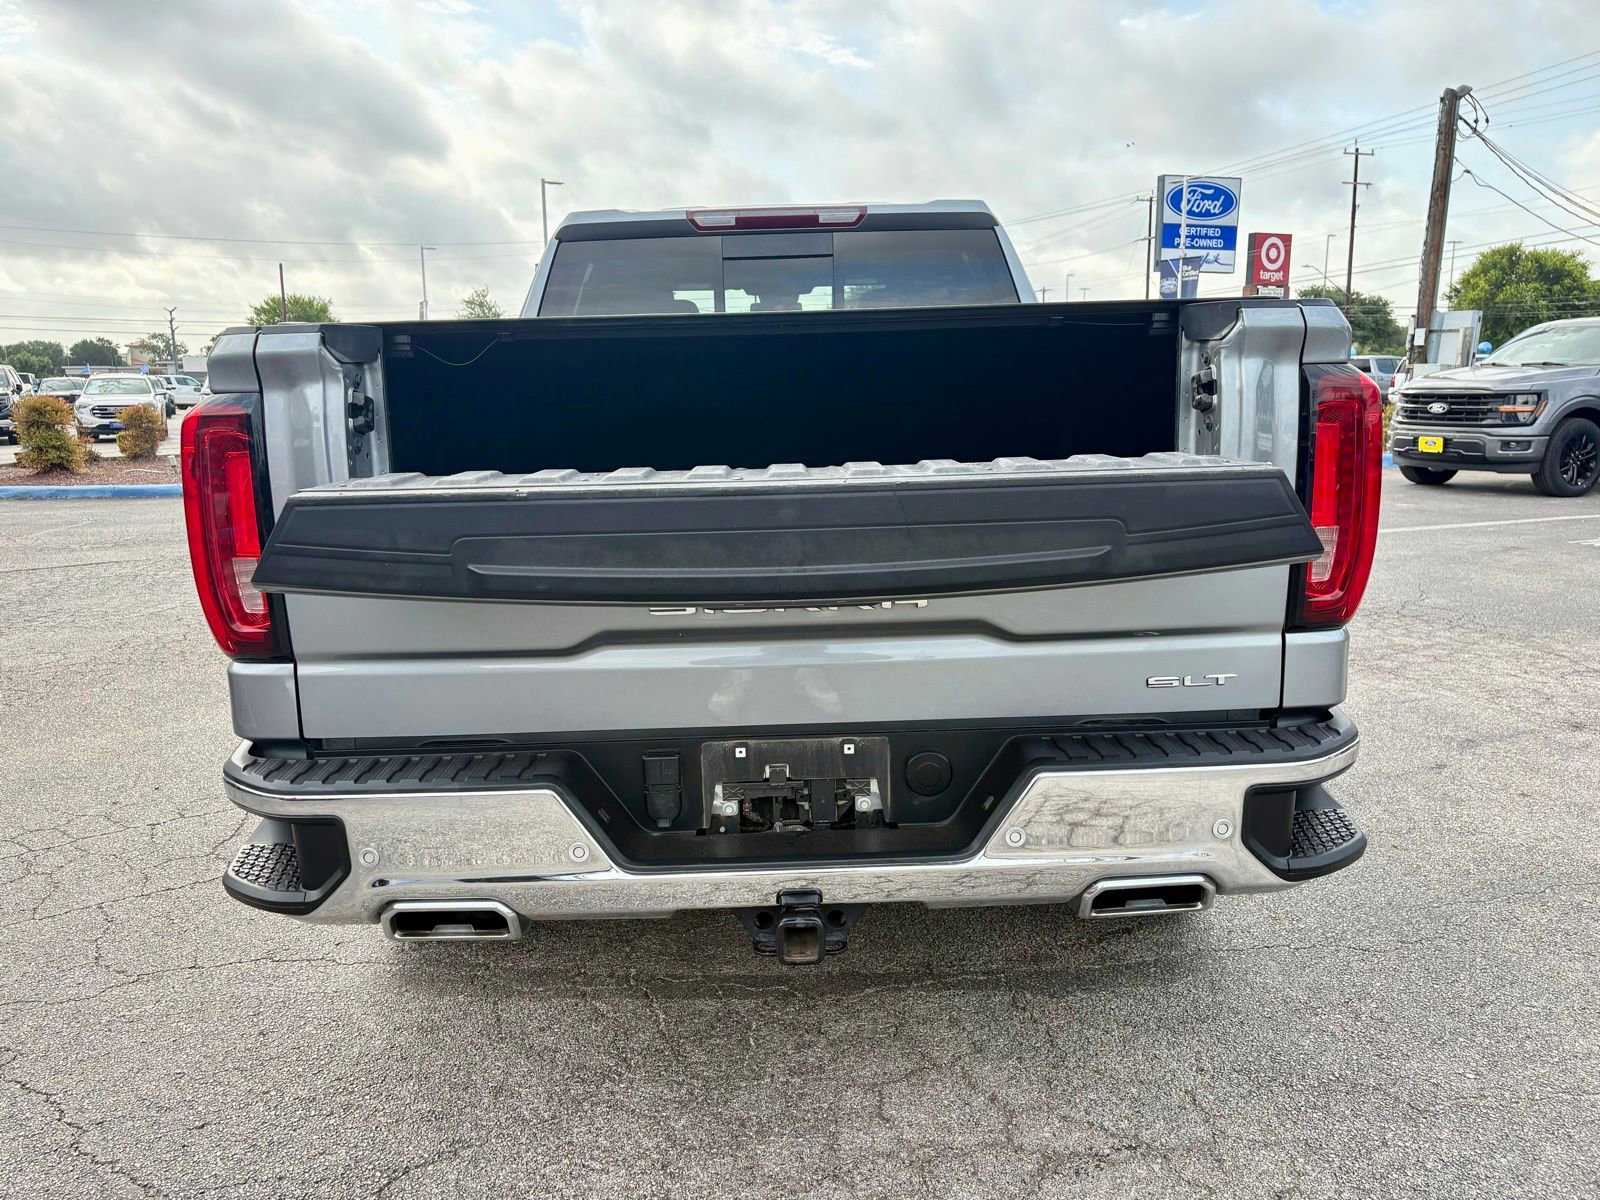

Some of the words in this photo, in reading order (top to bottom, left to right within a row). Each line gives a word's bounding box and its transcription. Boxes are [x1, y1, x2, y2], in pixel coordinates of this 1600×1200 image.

[1180, 186, 1225, 214] Ford
[1174, 237, 1224, 248] PE-OWNED
[1259, 269, 1284, 282] target
[1146, 673, 1238, 688] SLT
